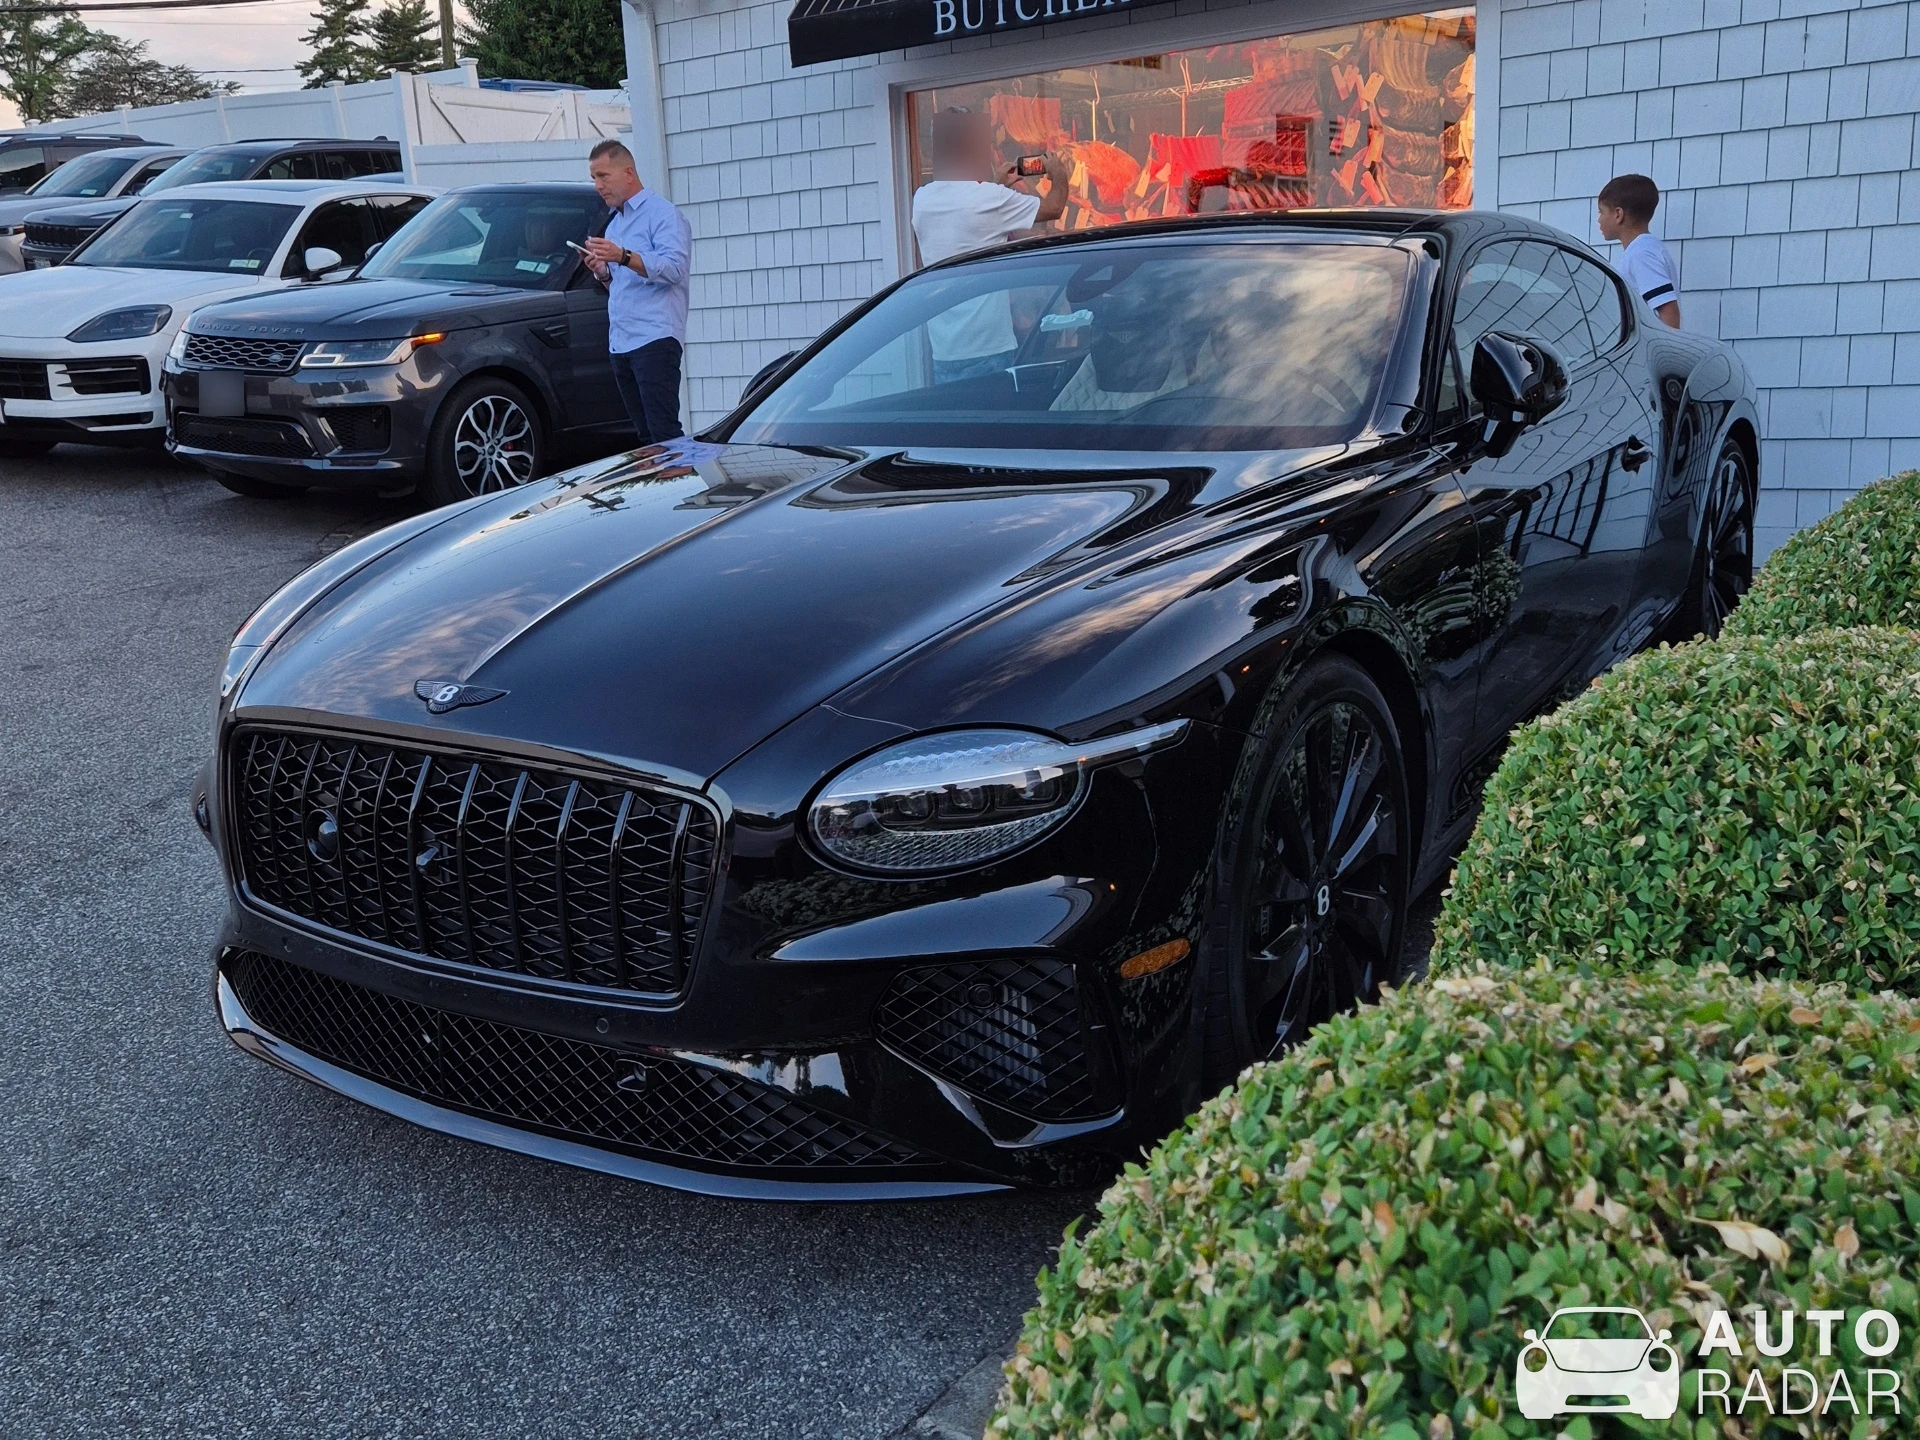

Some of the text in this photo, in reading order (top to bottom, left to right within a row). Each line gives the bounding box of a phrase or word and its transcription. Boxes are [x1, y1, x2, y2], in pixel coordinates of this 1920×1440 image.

[932, 0, 1131, 35] BUTC
[198, 322, 306, 335] RANGE ROVER
[435, 685, 460, 702] B
